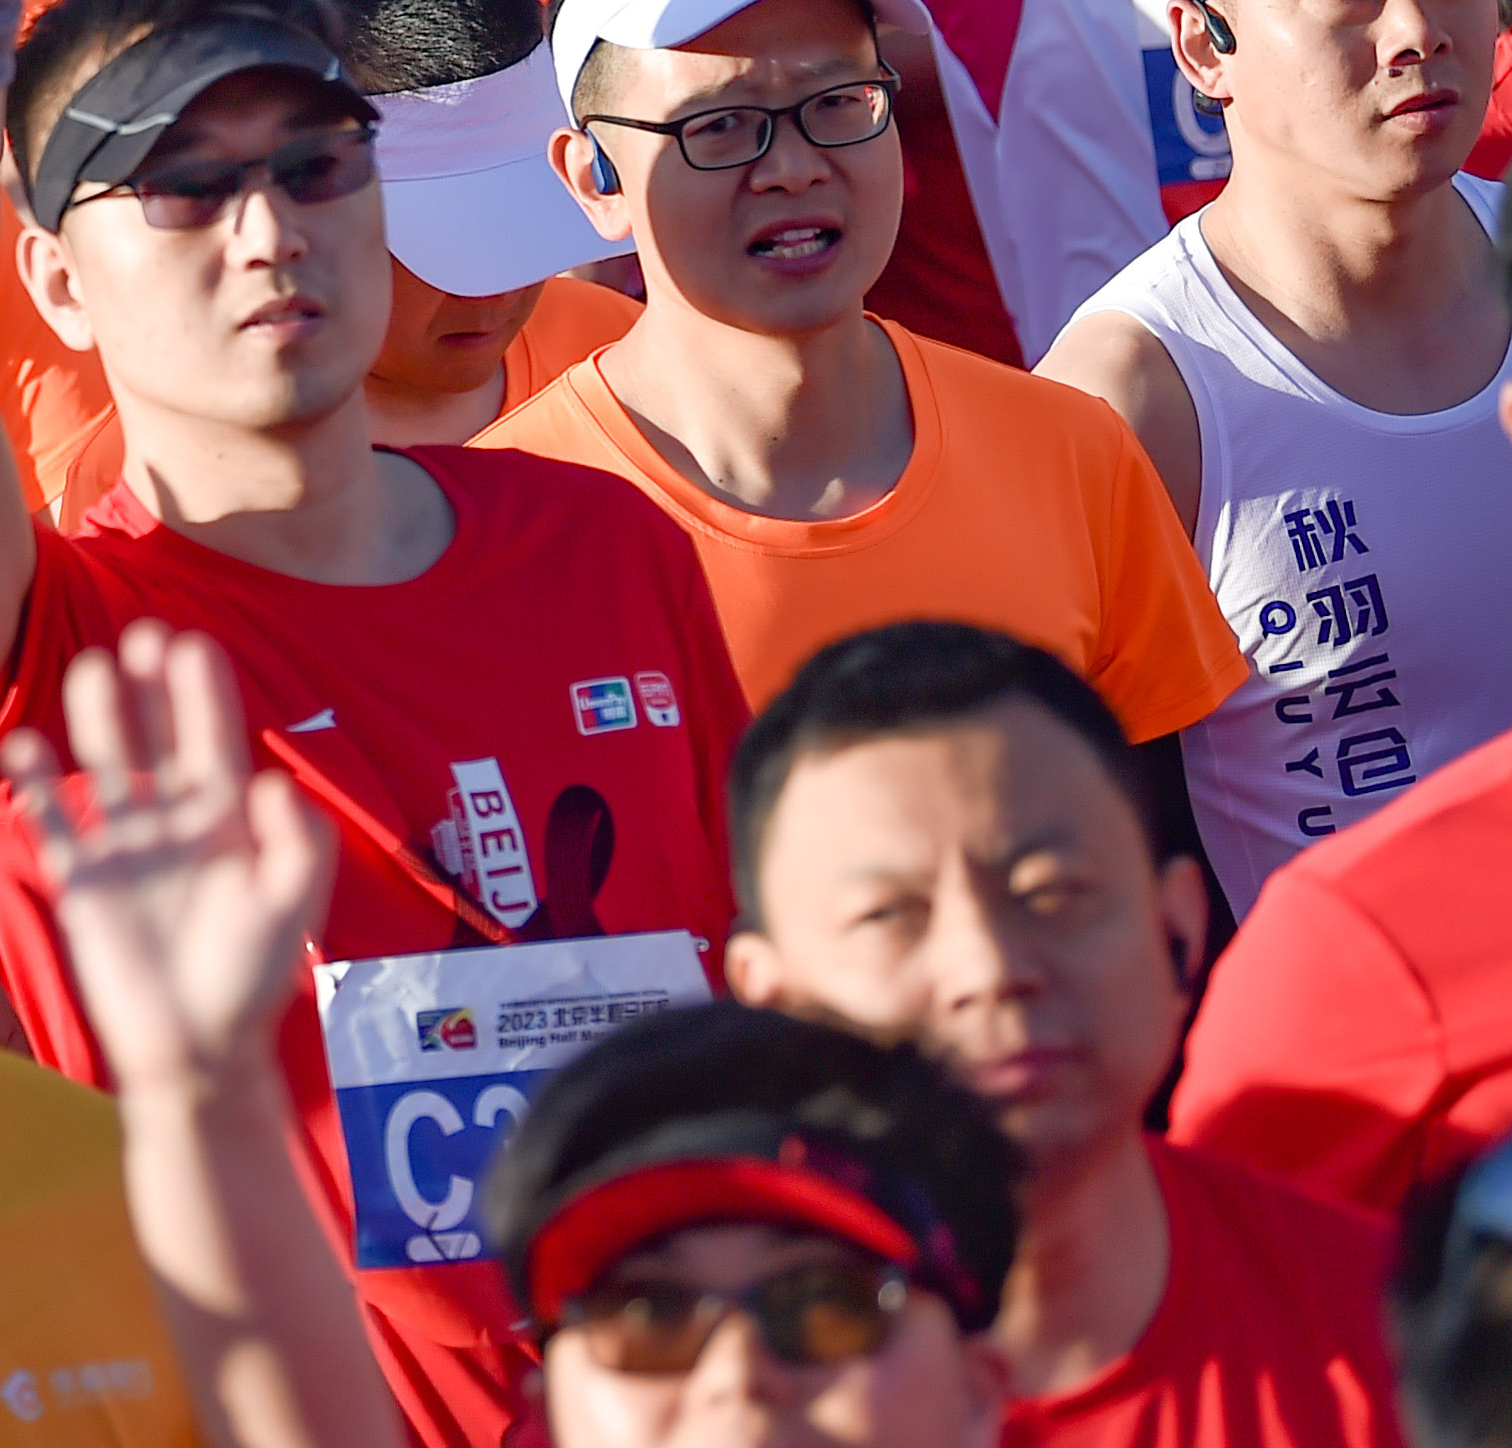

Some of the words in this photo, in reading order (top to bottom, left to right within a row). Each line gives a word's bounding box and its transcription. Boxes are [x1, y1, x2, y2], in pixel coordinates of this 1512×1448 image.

[470, 790, 529, 913] BEIJ
[497, 1010, 548, 1034] 2023
[552, 998, 670, 1028] 北京半程马
[499, 1034, 547, 1050] Beijing
